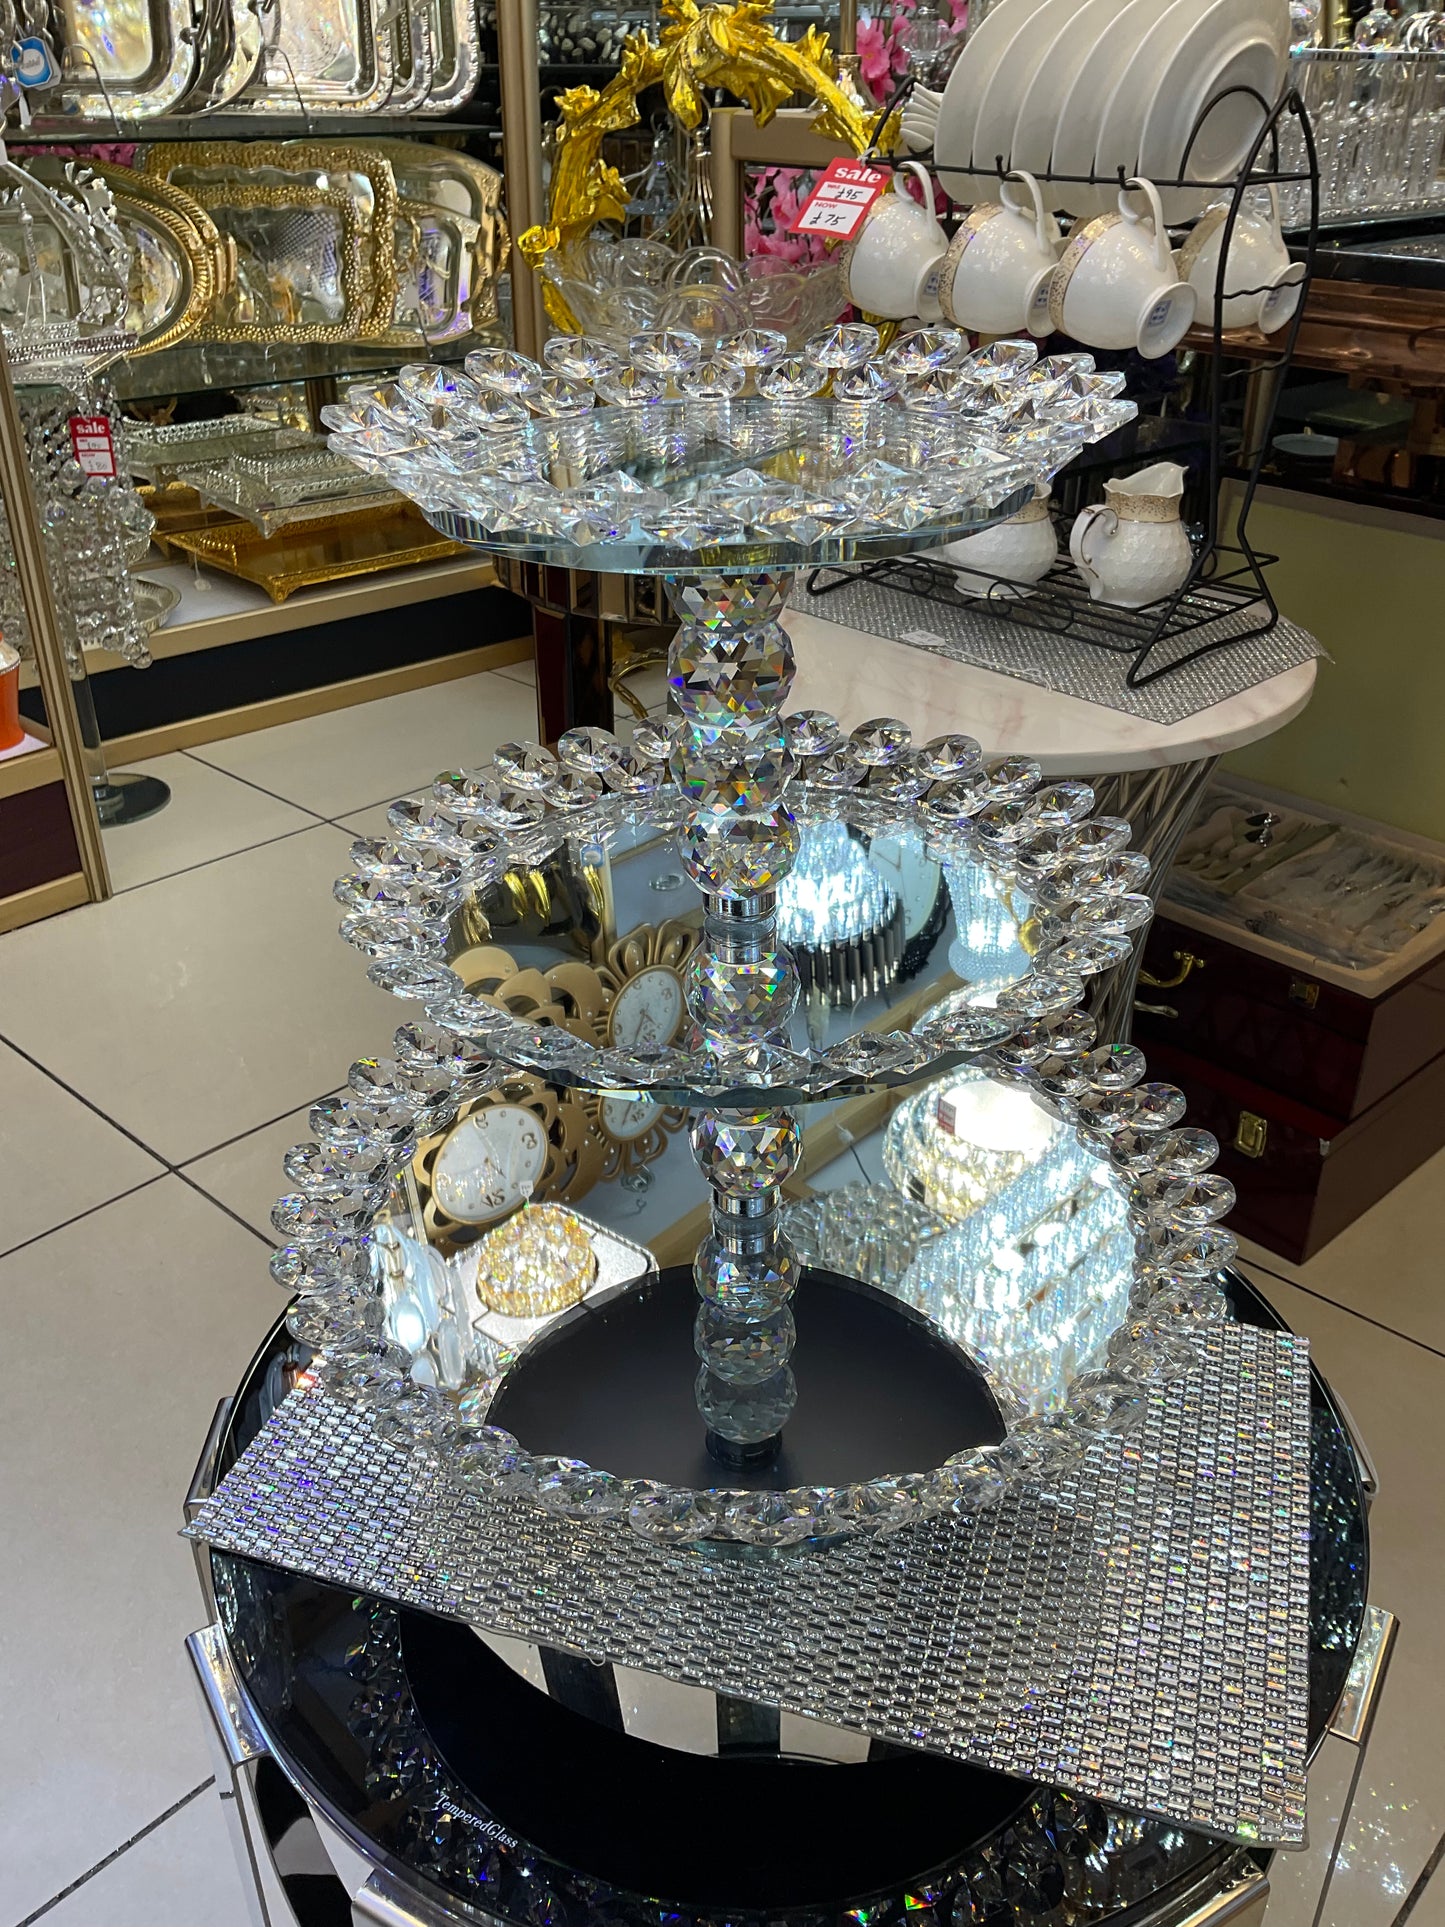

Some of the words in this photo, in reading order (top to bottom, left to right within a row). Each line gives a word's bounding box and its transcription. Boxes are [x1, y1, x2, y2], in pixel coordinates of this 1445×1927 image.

[834, 167, 882, 183] sale
[834, 187, 863, 200] £95
[814, 201, 838, 209] NOW
[76, 422, 105, 434] sale
[435, 1793, 519, 1848] TemperedGlass
